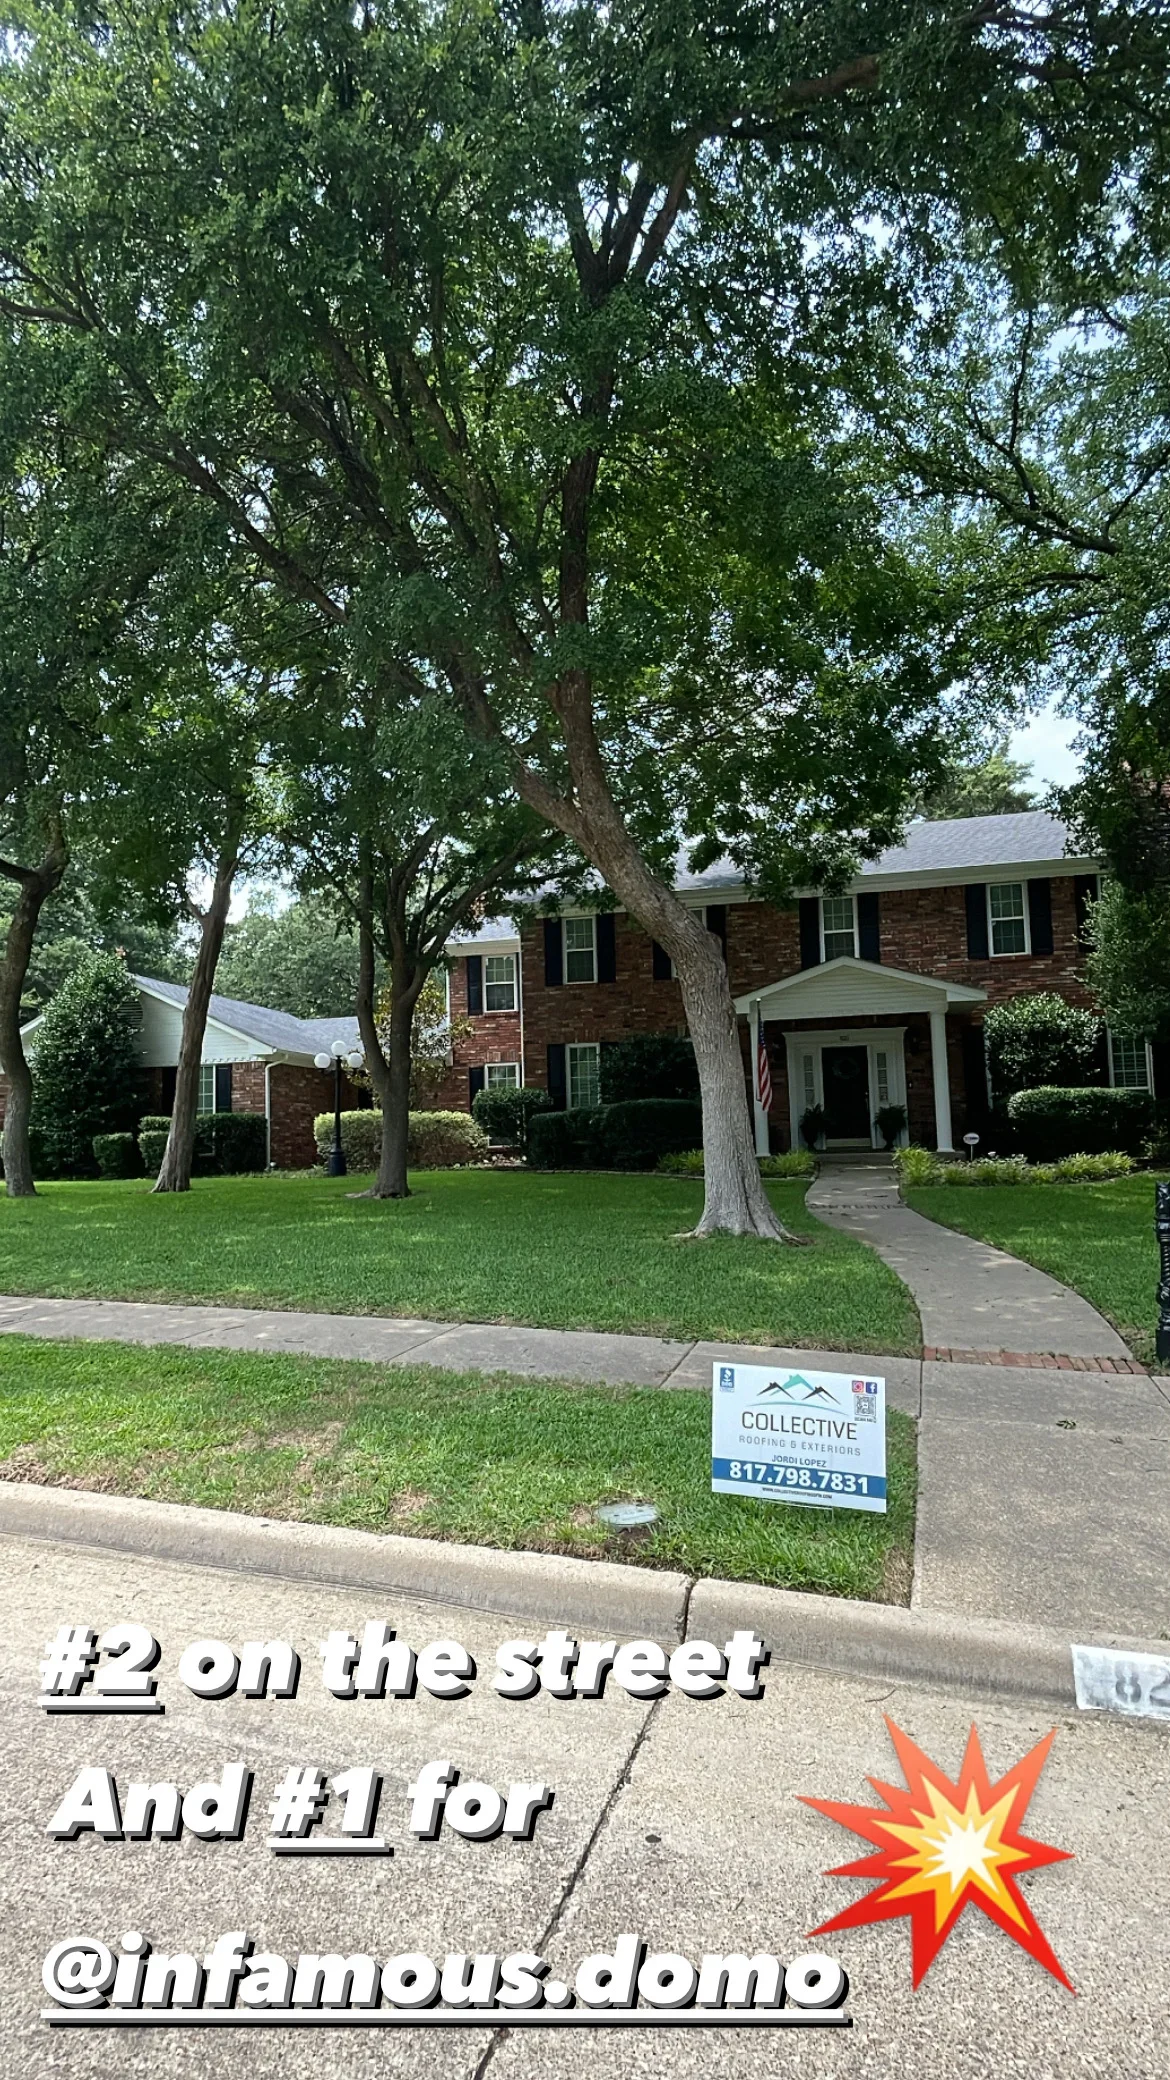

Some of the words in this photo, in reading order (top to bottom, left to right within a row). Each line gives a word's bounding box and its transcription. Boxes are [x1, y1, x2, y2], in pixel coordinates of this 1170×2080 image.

[741, 1411, 858, 1441] COLLECTIVE
[739, 1435, 786, 1448] ROOFING
[801, 1441, 861, 1456] EXTERIORS
[772, 1454, 798, 1464] JORDI
[799, 1457, 828, 1468] LOPEZ
[729, 1461, 869, 1494] 817.798.7831
